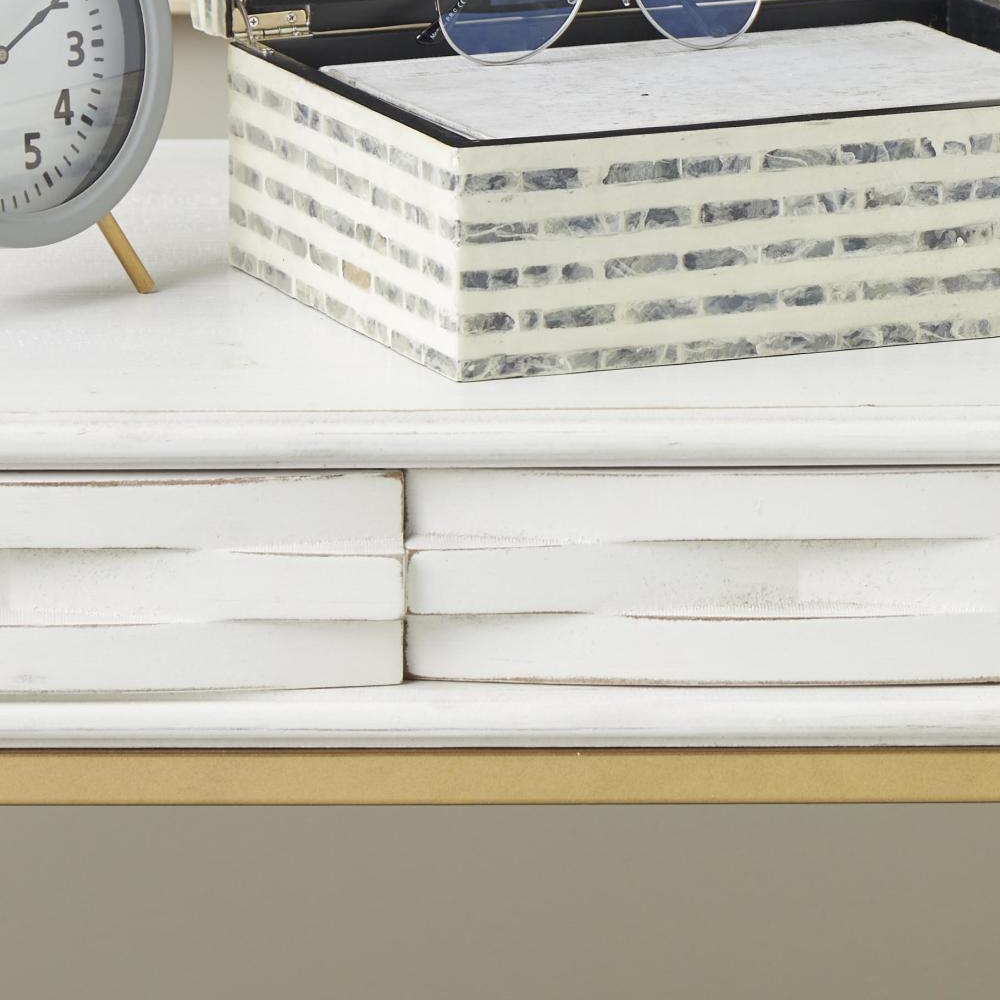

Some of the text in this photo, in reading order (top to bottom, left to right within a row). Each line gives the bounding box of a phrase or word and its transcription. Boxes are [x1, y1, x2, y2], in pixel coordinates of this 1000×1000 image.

[67, 30, 85, 67] 3
[54, 88, 75, 126] 4
[24, 132, 42, 170] 5
